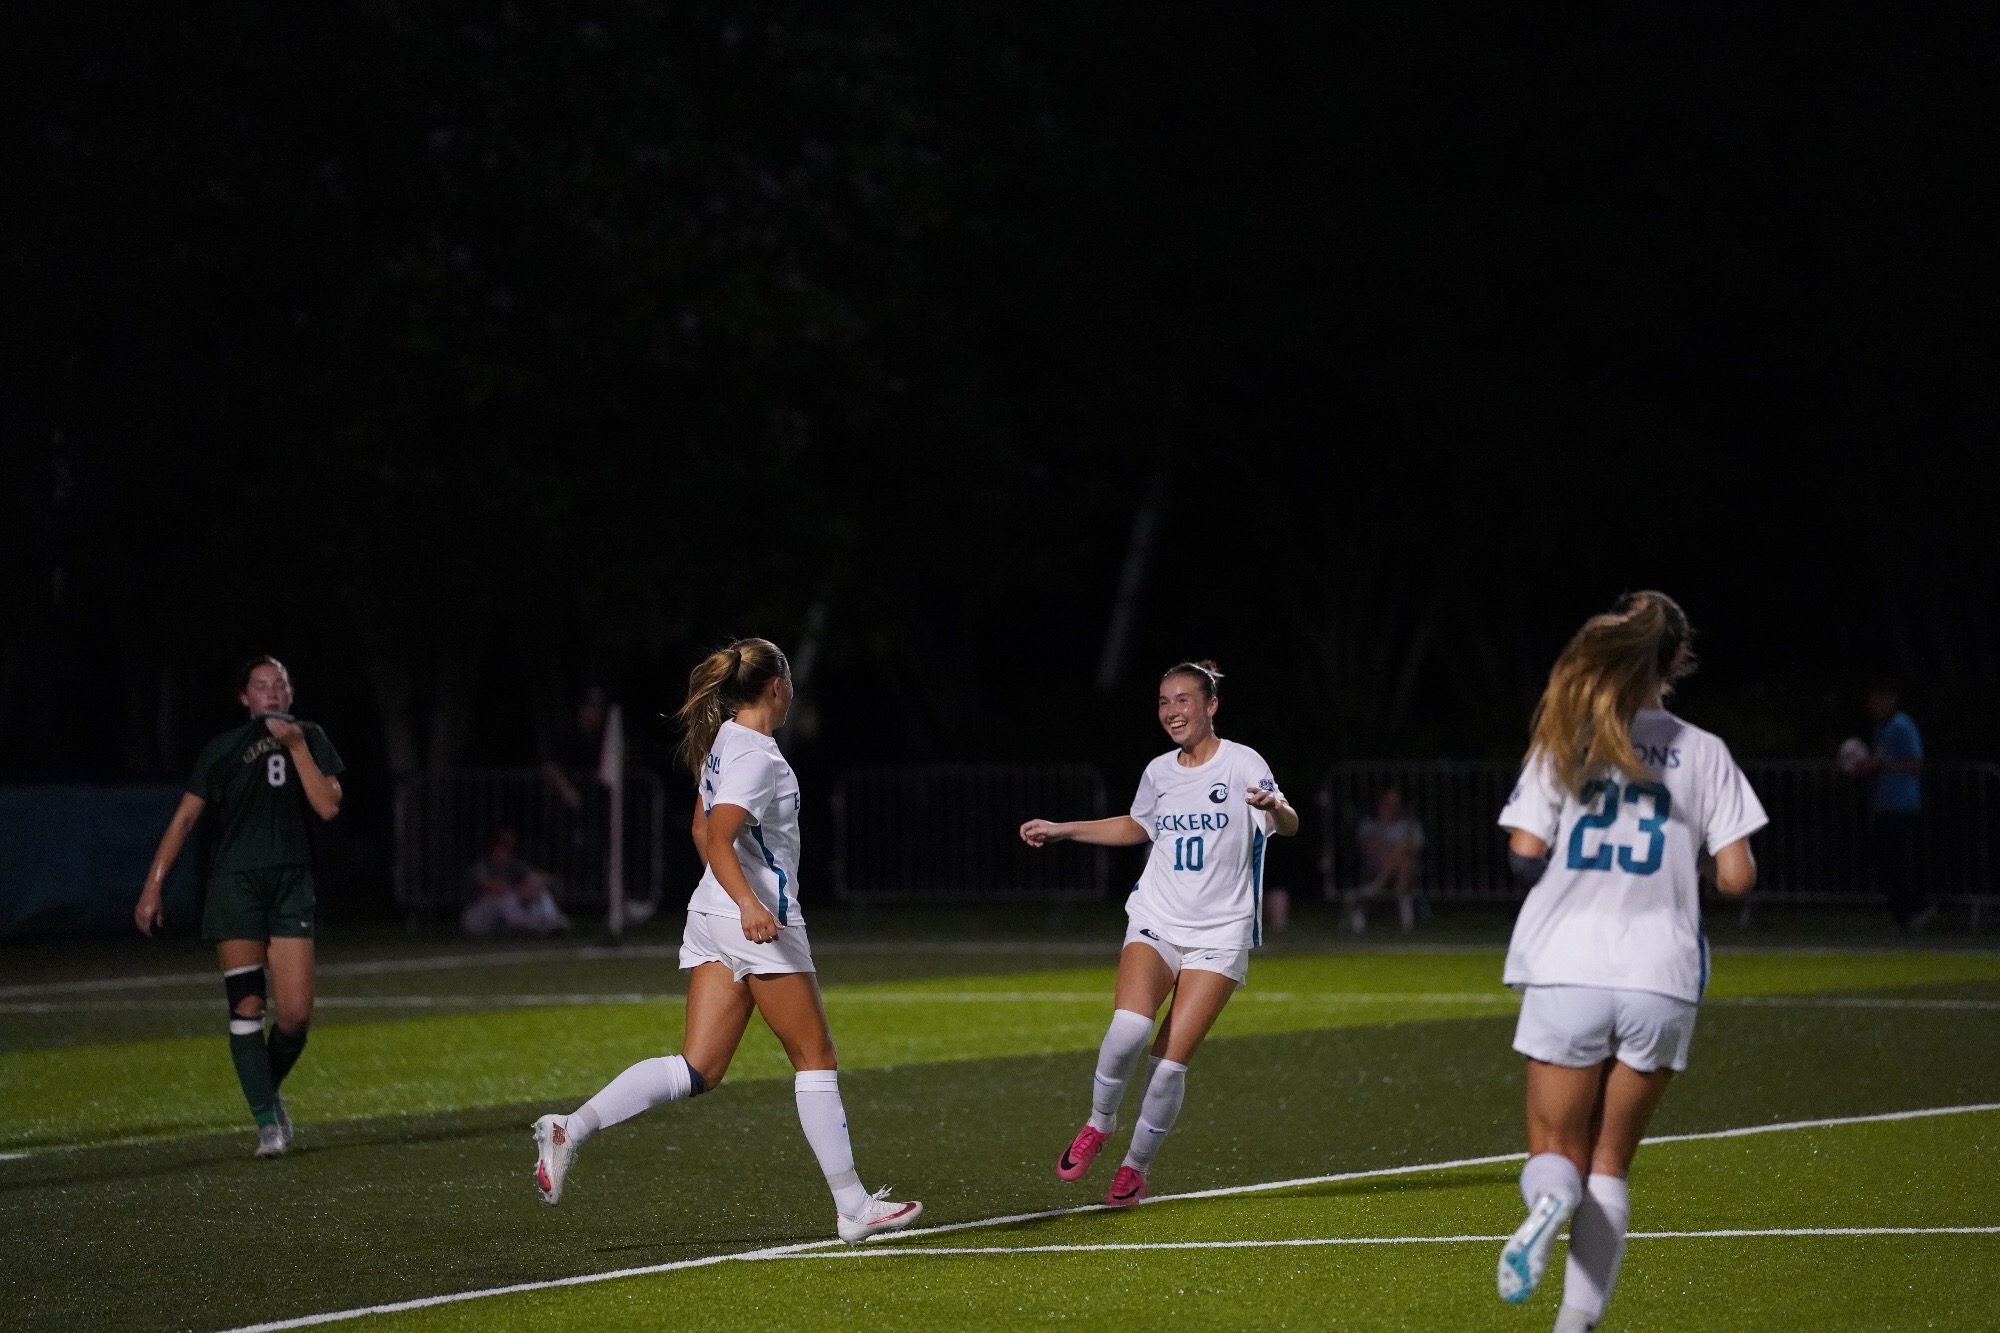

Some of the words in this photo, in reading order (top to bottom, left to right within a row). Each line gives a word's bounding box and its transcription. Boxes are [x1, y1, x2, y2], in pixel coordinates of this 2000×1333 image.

[269, 755, 285, 786] 8
[1568, 780, 1671, 875] 23
[1174, 837, 1204, 871] 10
